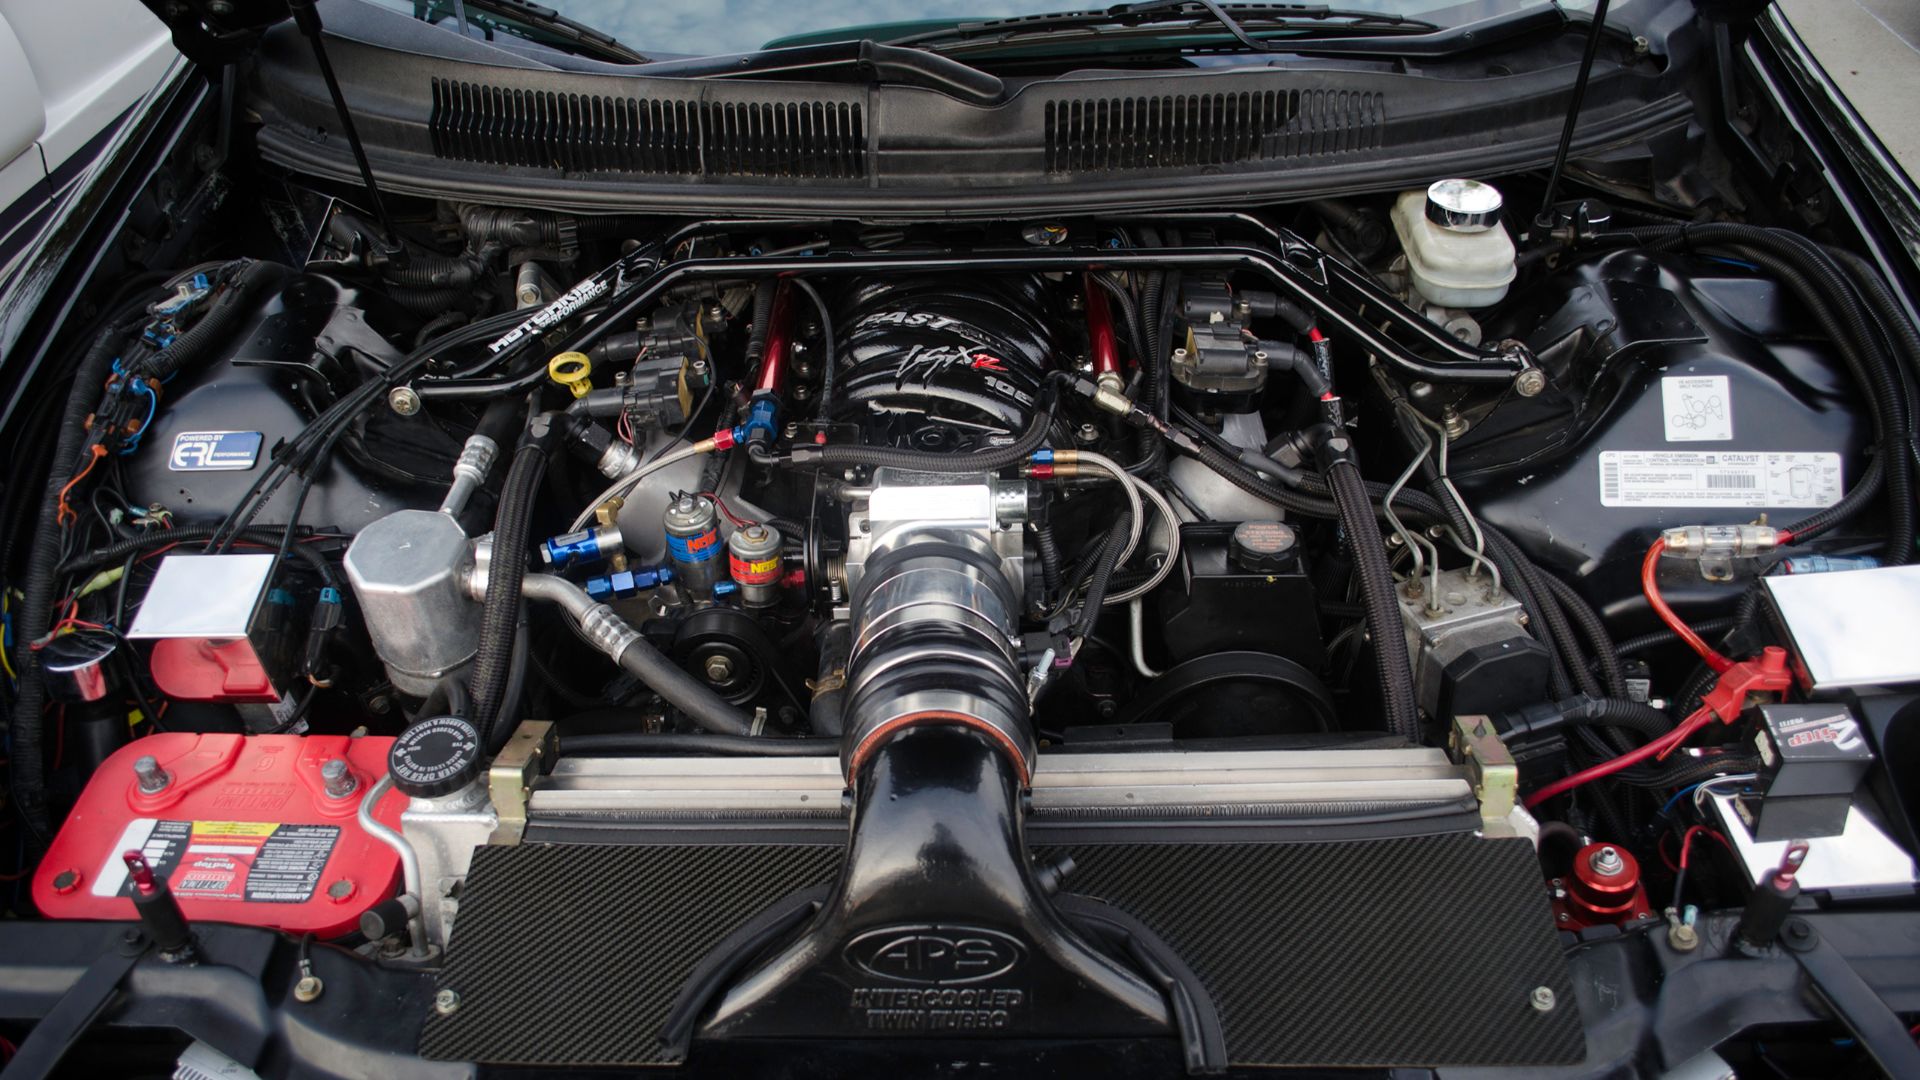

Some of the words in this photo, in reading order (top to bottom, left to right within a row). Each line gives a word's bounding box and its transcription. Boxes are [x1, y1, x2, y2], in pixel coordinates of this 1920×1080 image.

[540, 280, 609, 328] PERFORMANCE
[856, 311, 962, 330] FAST
[180, 434, 213, 442] POWERED
[213, 434, 225, 442] BY
[1721, 454, 1759, 463] CATALYST
[396, 764, 412, 777] HOT
[438, 758, 467, 778] NEVER
[410, 772, 435, 781] OPEN
[193, 861, 235, 870] RedTop
[177, 880, 231, 890] OPTIMA
[869, 935, 998, 970] APS
[866, 1009, 925, 1029] TWIN
[929, 1009, 1008, 1029] TURBO
